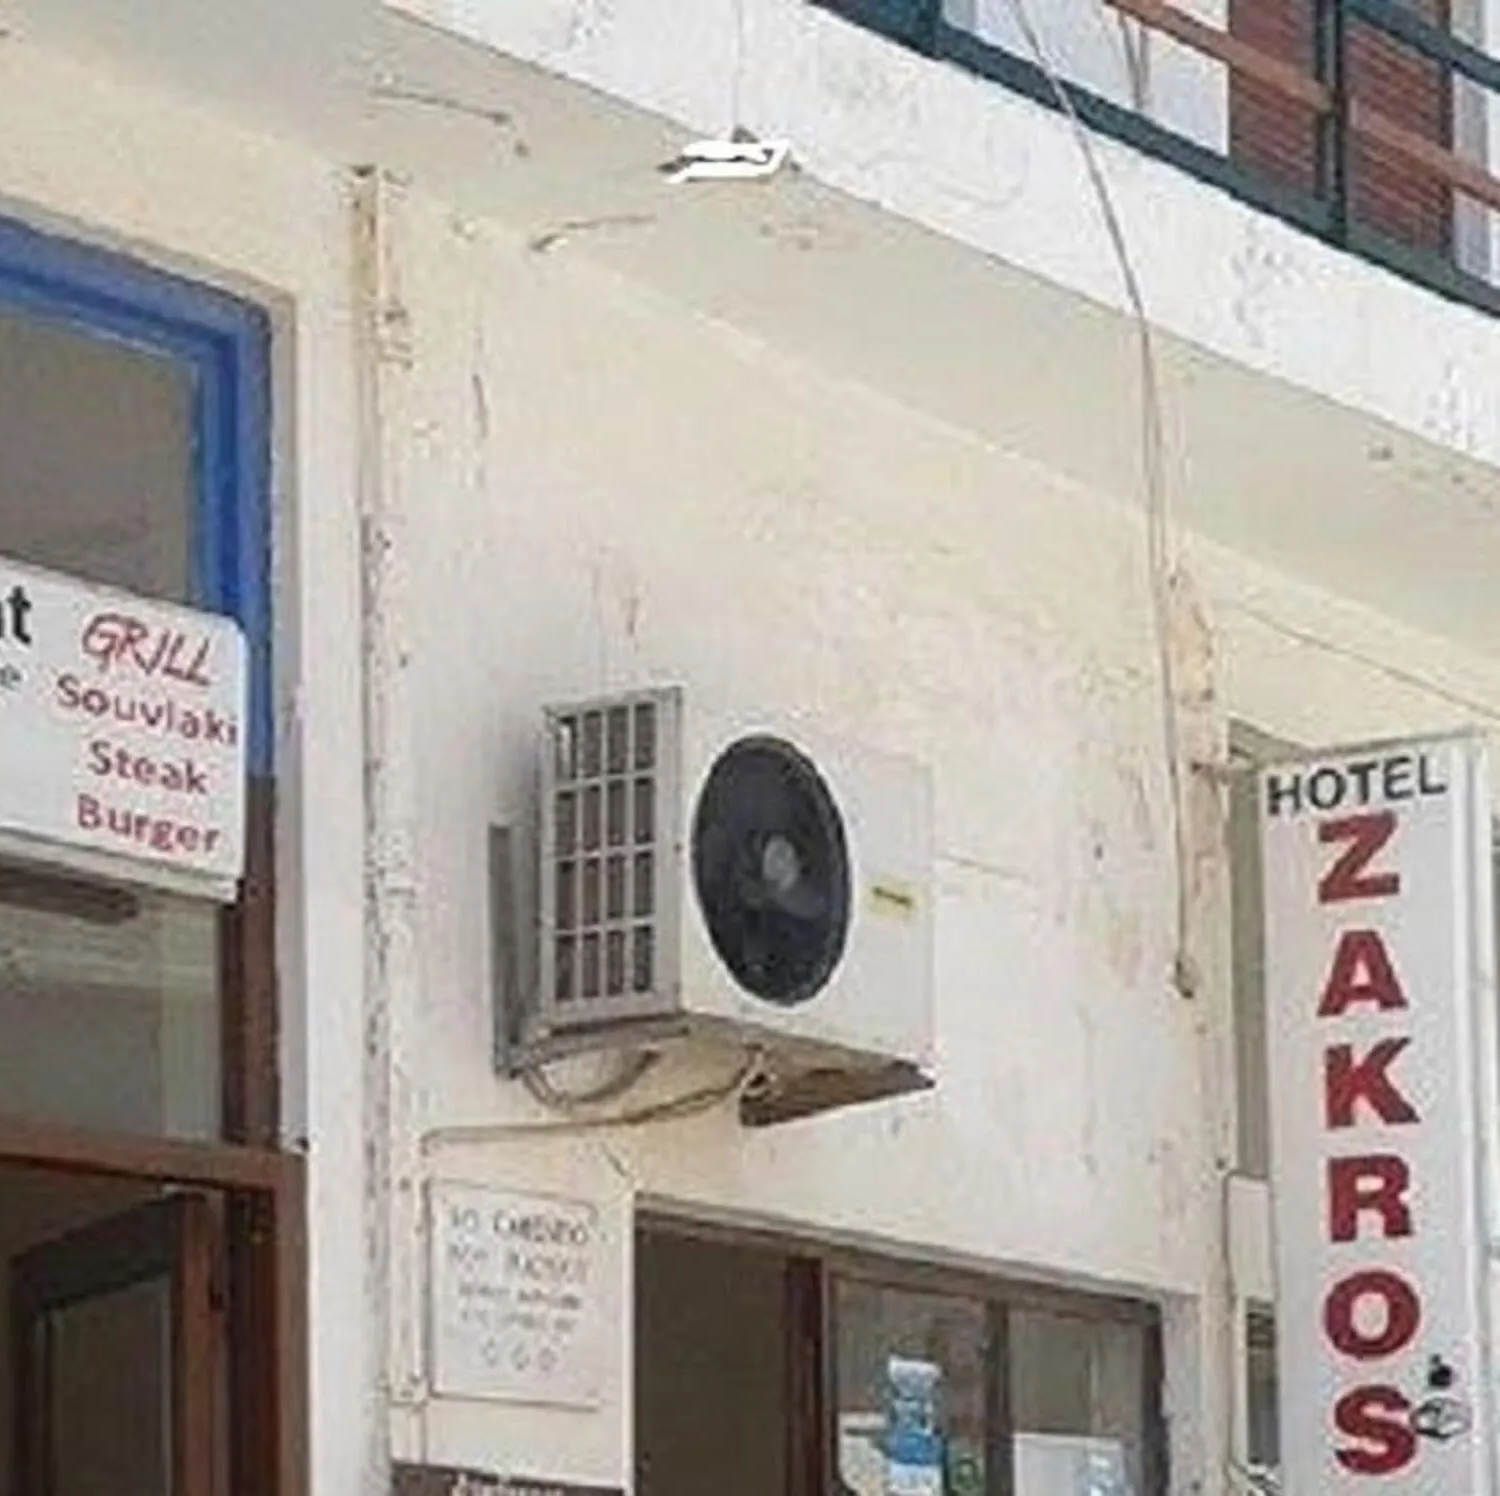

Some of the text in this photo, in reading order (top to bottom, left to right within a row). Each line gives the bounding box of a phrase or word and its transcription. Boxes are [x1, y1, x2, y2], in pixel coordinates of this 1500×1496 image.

[80, 611, 213, 687] GRILL
[56, 673, 238, 748] Souvlaki
[87, 740, 210, 796] Steak
[1267, 753, 1449, 816] HOTEL
[75, 797, 220, 856] Burger
[1317, 809, 1421, 1476] ZAKROS
